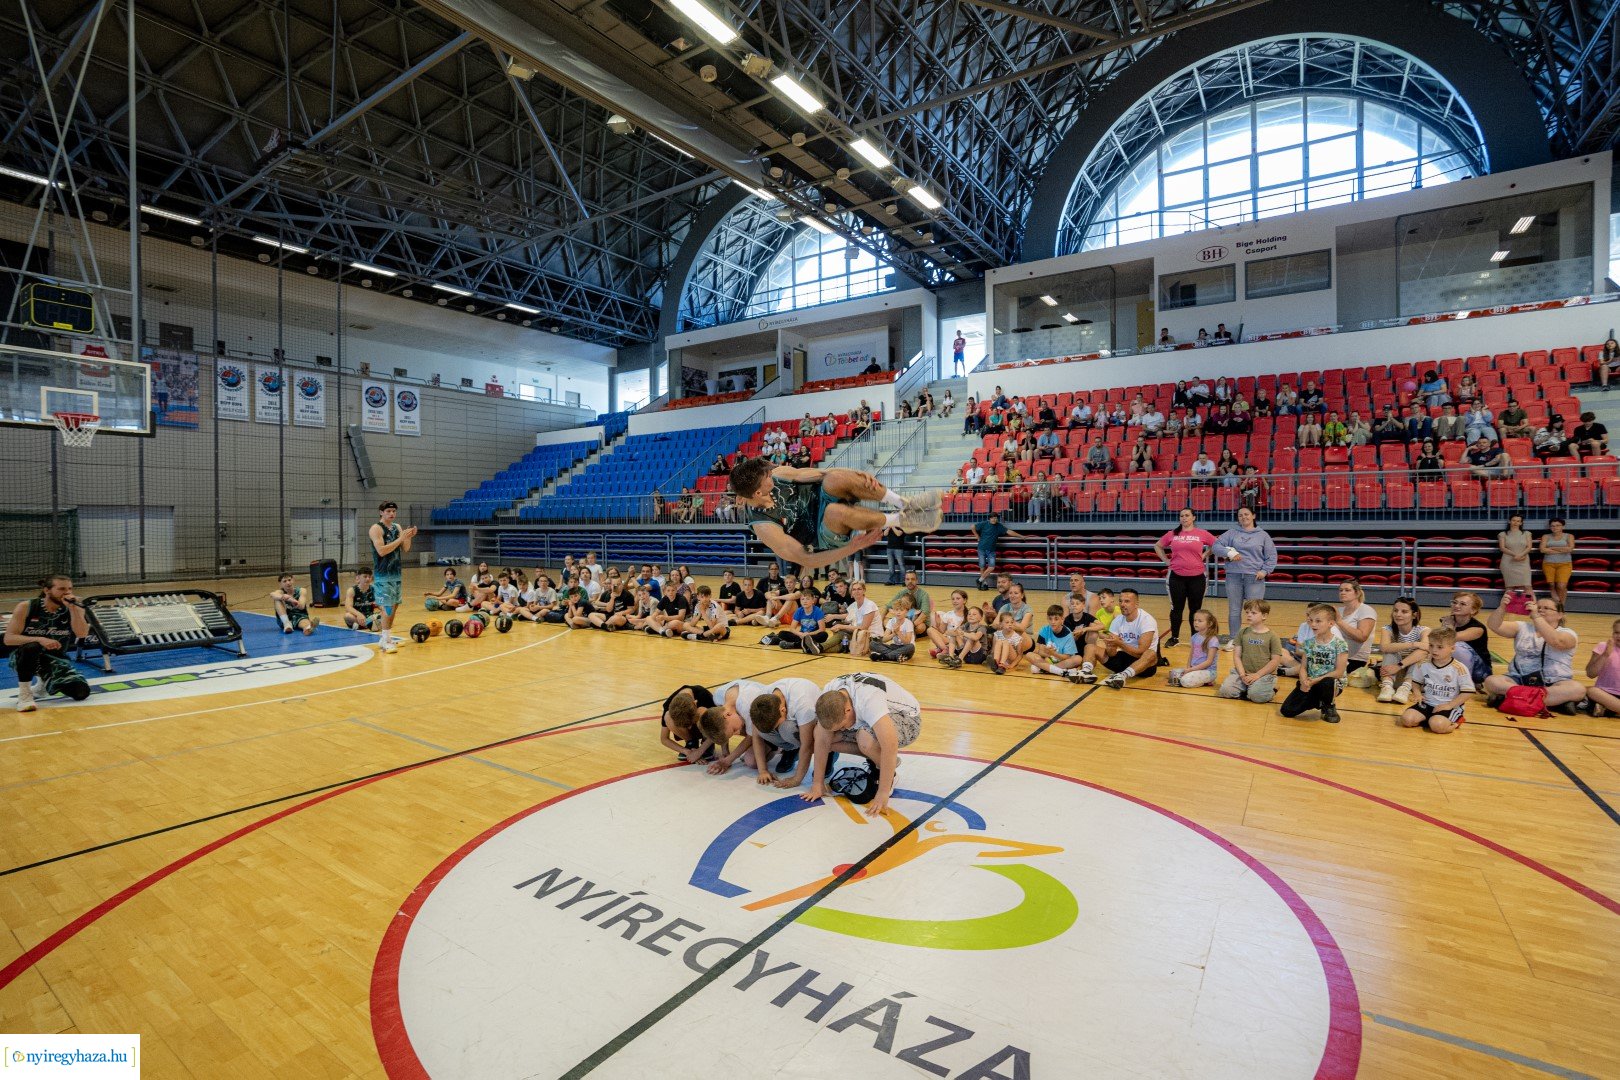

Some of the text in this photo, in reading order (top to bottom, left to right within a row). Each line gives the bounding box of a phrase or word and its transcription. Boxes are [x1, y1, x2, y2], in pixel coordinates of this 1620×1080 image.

[1236, 234, 1288, 248] Bige Holding
[1202, 247, 1223, 261] BH
[1245, 245, 1278, 255] Csoport
[512, 867, 1032, 1080] NYÍREGYHÁZA
